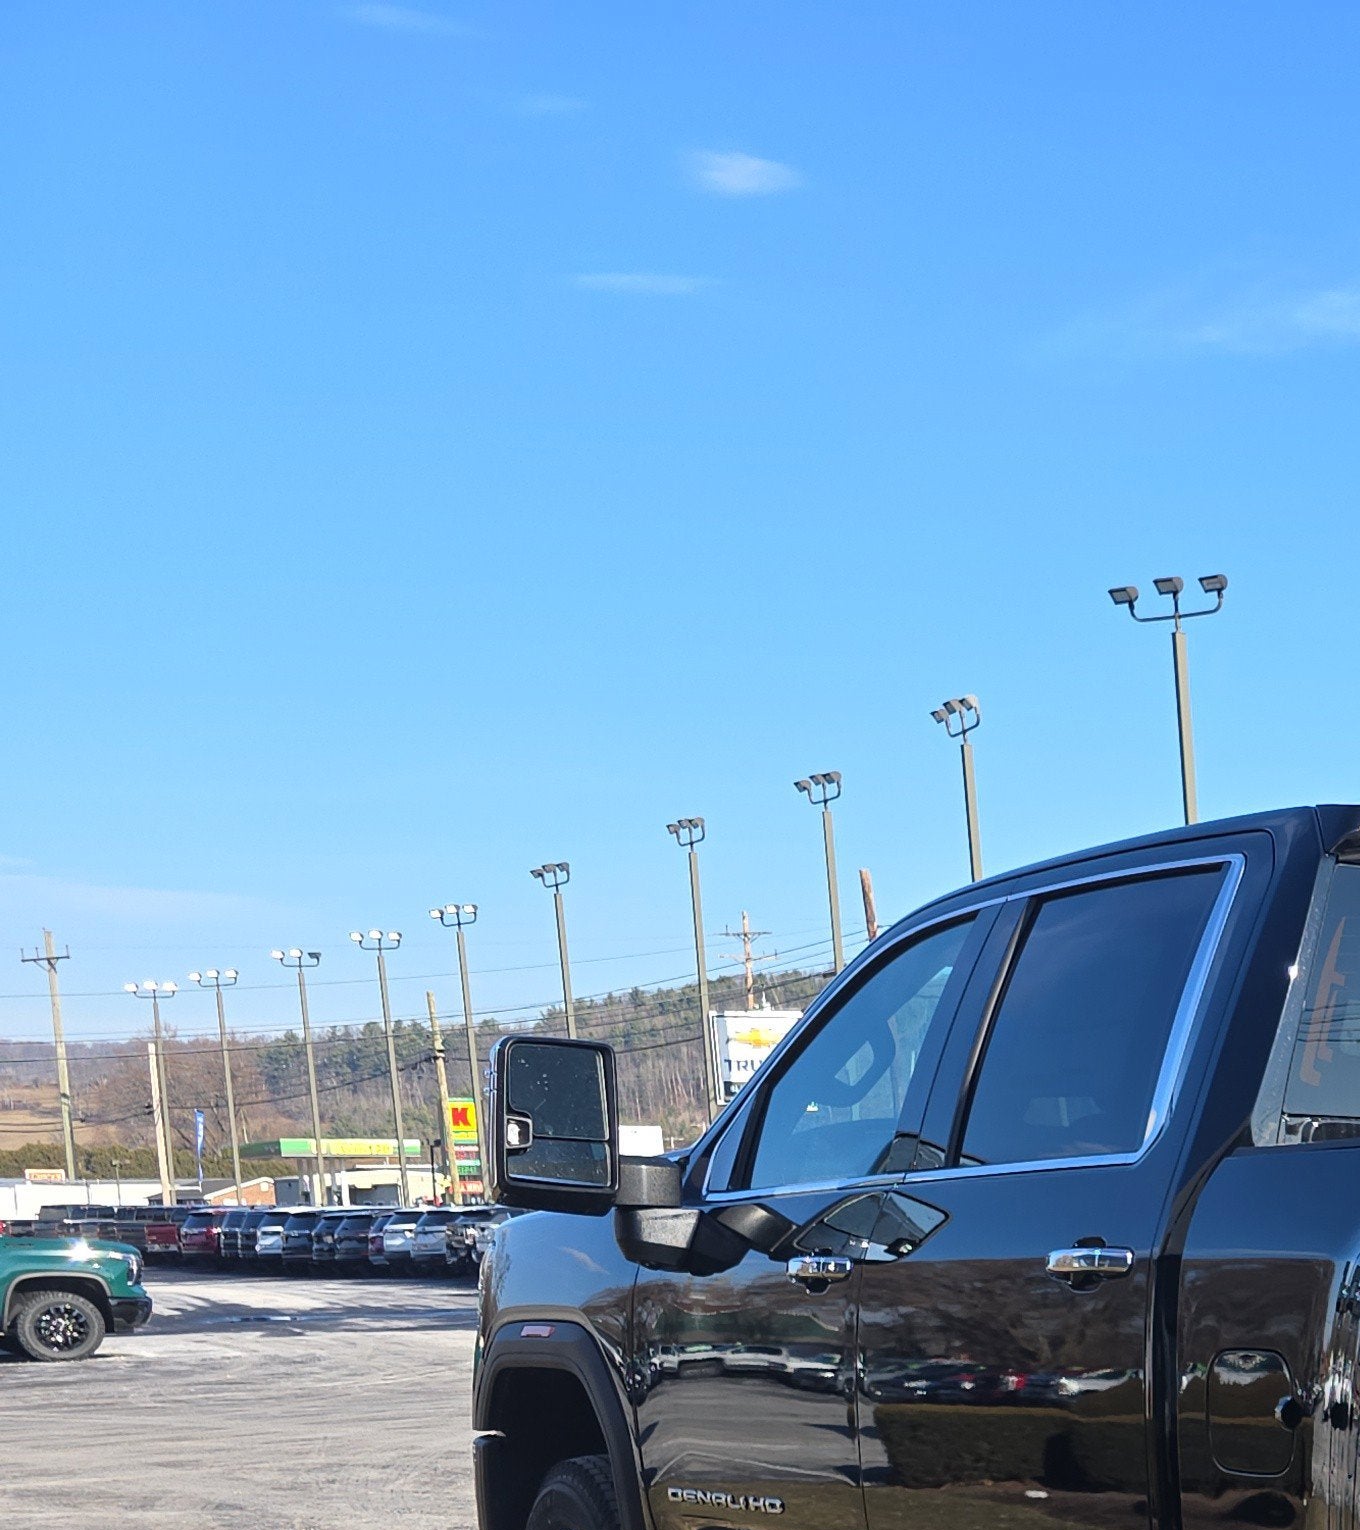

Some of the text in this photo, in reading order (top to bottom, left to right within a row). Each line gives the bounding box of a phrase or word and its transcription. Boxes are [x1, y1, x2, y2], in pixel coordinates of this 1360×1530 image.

[451, 1107, 472, 1127] K
[667, 1487, 786, 1514] DENALI HD
